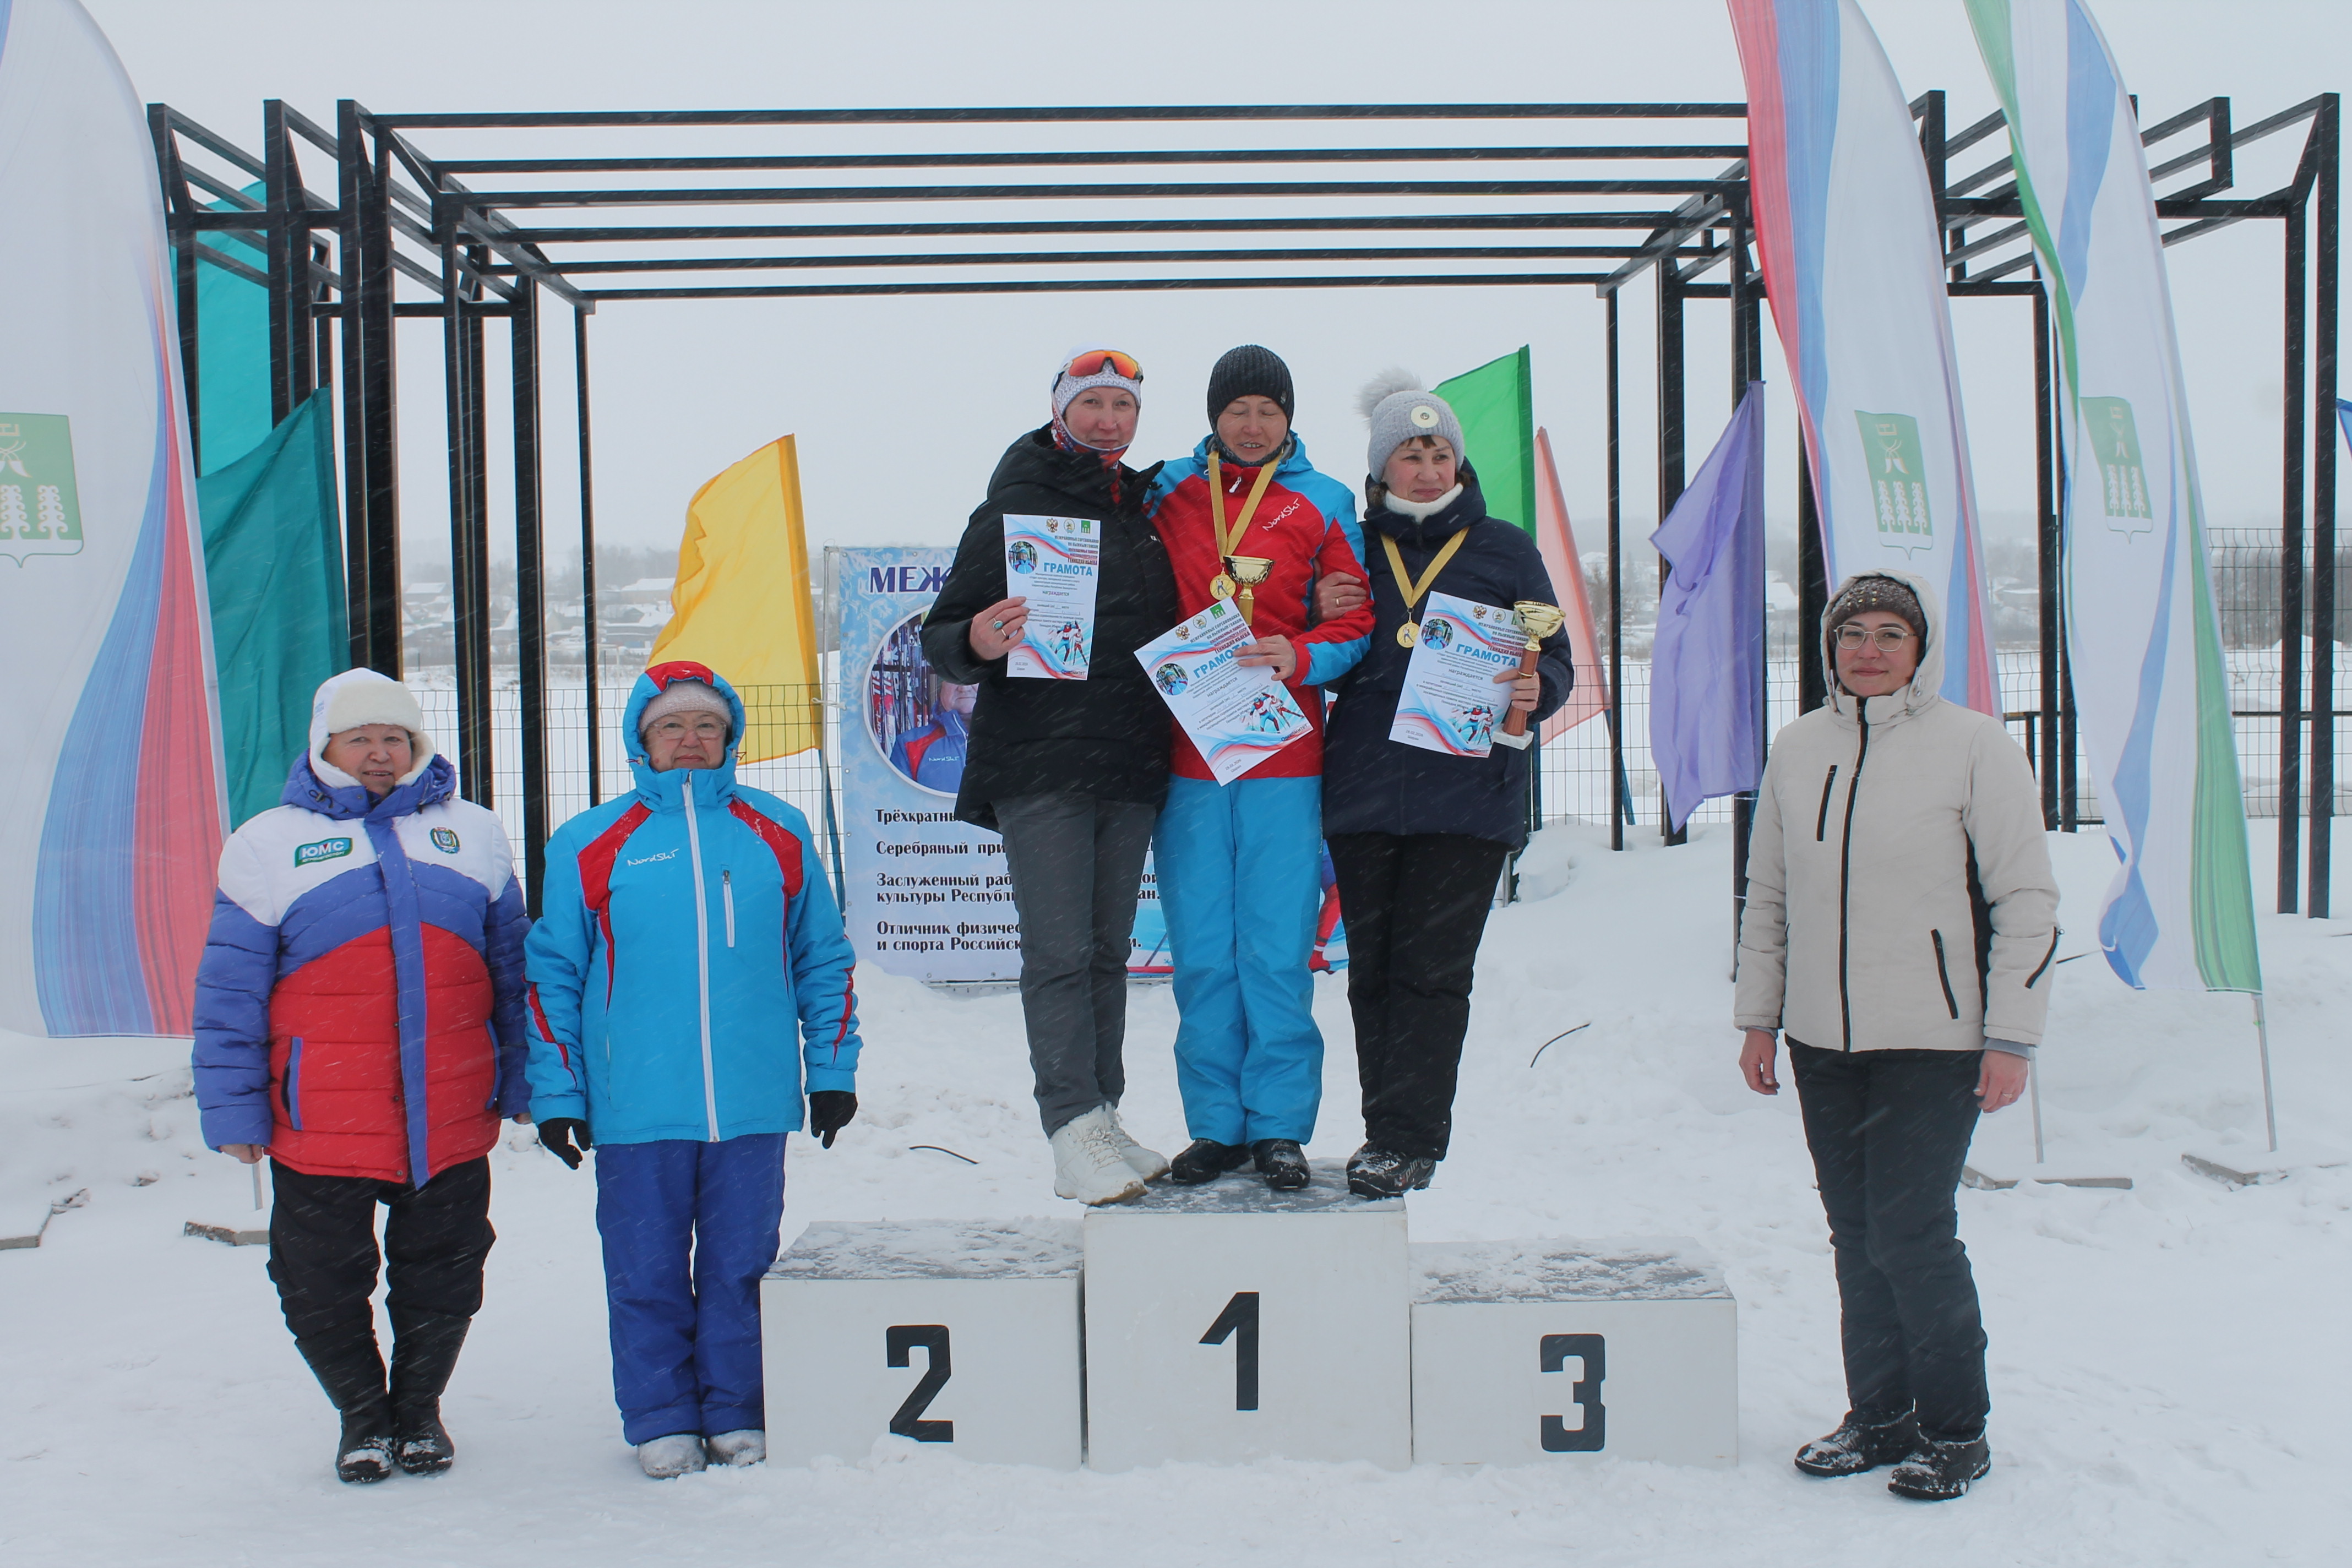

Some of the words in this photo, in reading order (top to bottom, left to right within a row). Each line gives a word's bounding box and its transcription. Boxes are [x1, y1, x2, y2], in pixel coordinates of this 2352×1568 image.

[1262, 498, 1300, 531] NordSki
[1043, 562, 1093, 576] ГРАМОТА
[870, 567, 953, 593] МЕЖ
[1456, 643, 1517, 667] ГРАМОТА
[1448, 668, 1483, 681] награждается
[302, 841, 345, 858] ЮМС
[627, 848, 680, 867] NordSki
[876, 841, 968, 857] Серебряный
[978, 843, 1006, 857] при
[876, 873, 979, 889] Заслуженный
[986, 874, 1013, 889] раб
[877, 892, 945, 905] культуры
[877, 921, 951, 934] Отличник
[877, 940, 887, 951] и
[893, 940, 944, 953] спорта
[951, 937, 1022, 951] Российск
[1199, 1292, 1259, 1411] 1
[886, 1325, 953, 1442] 2
[1540, 1334, 1605, 1452] 3
